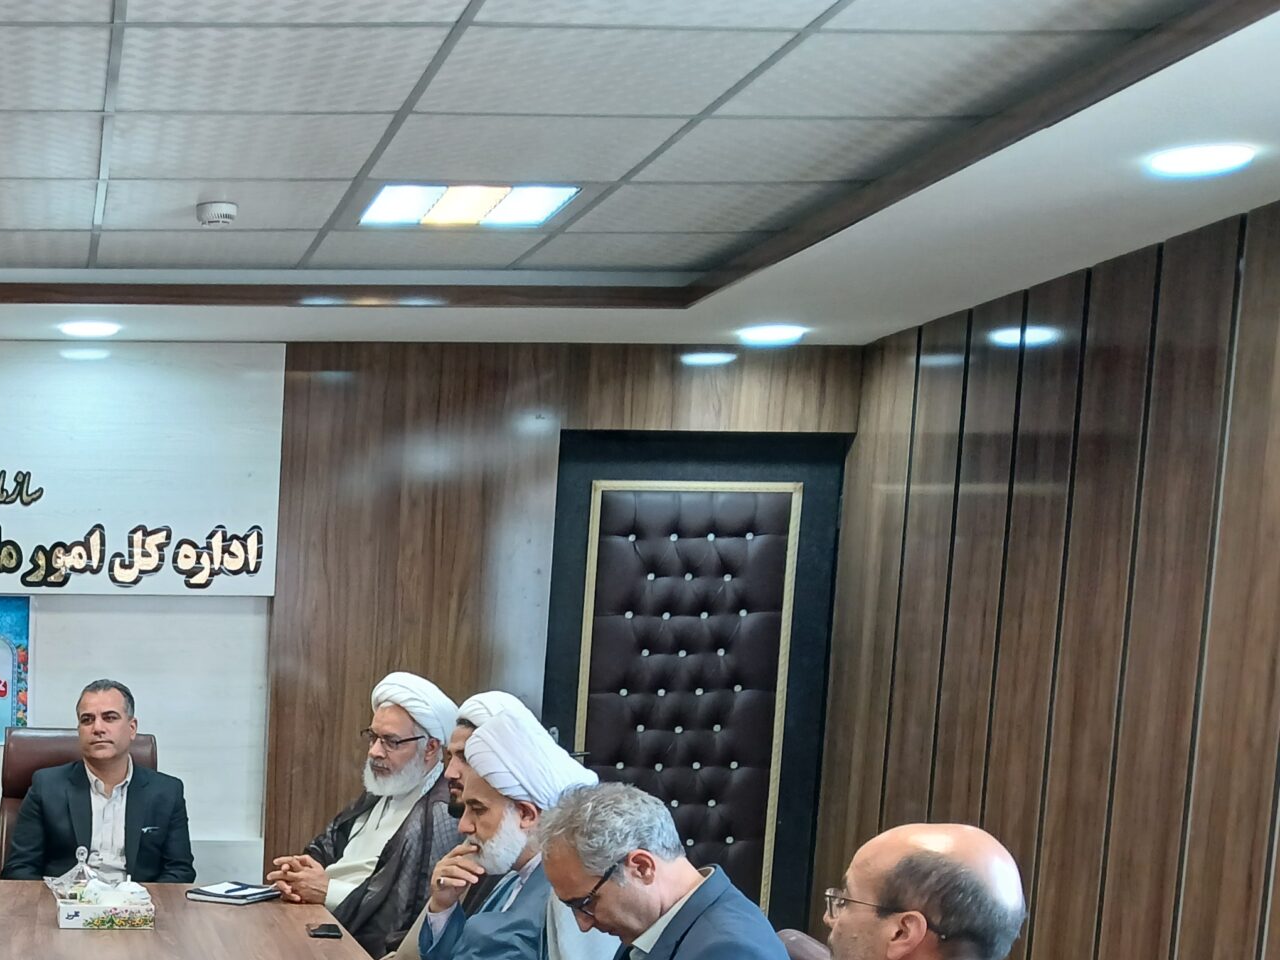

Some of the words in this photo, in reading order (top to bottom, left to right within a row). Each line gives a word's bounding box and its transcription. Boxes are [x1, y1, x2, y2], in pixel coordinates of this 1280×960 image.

[20, 523, 106, 587] امور
[108, 524, 172, 587] کل
[172, 524, 263, 588] اداره
